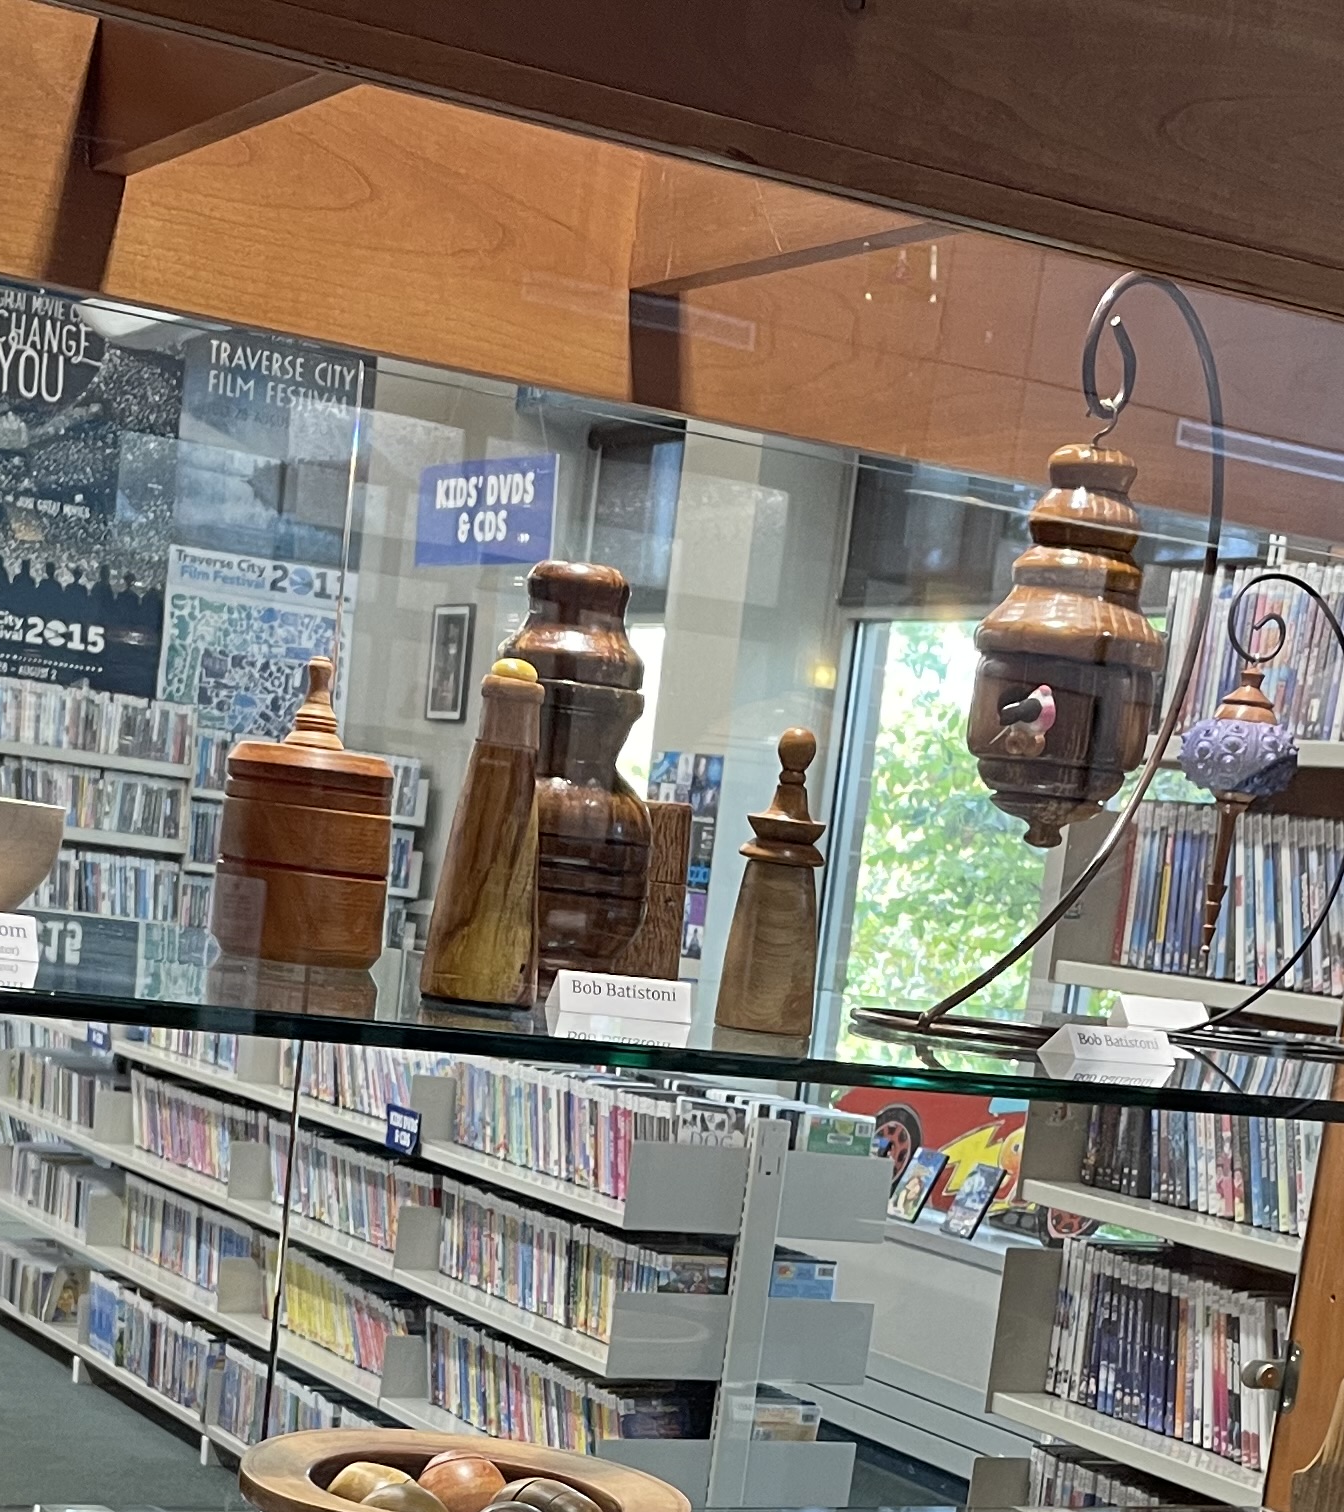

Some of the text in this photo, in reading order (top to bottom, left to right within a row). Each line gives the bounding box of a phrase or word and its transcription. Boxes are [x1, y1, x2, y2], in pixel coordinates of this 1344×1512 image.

[210, 339, 356, 390] TRAVERSE CITY
[208, 370, 255, 400] FILM
[265, 381, 350, 420] FESTIVAL
[435, 471, 535, 509] KIDS' DVDS
[457, 510, 508, 543] & CDS
[175, 549, 233, 570] Traverse
[237, 559, 266, 578] City
[180, 565, 265, 589] Film Festival
[25, 616, 105, 653] 2015
[572, 979, 677, 1001] Bob Batistoni
[1077, 1032, 1159, 1050] Bob Batistoni
